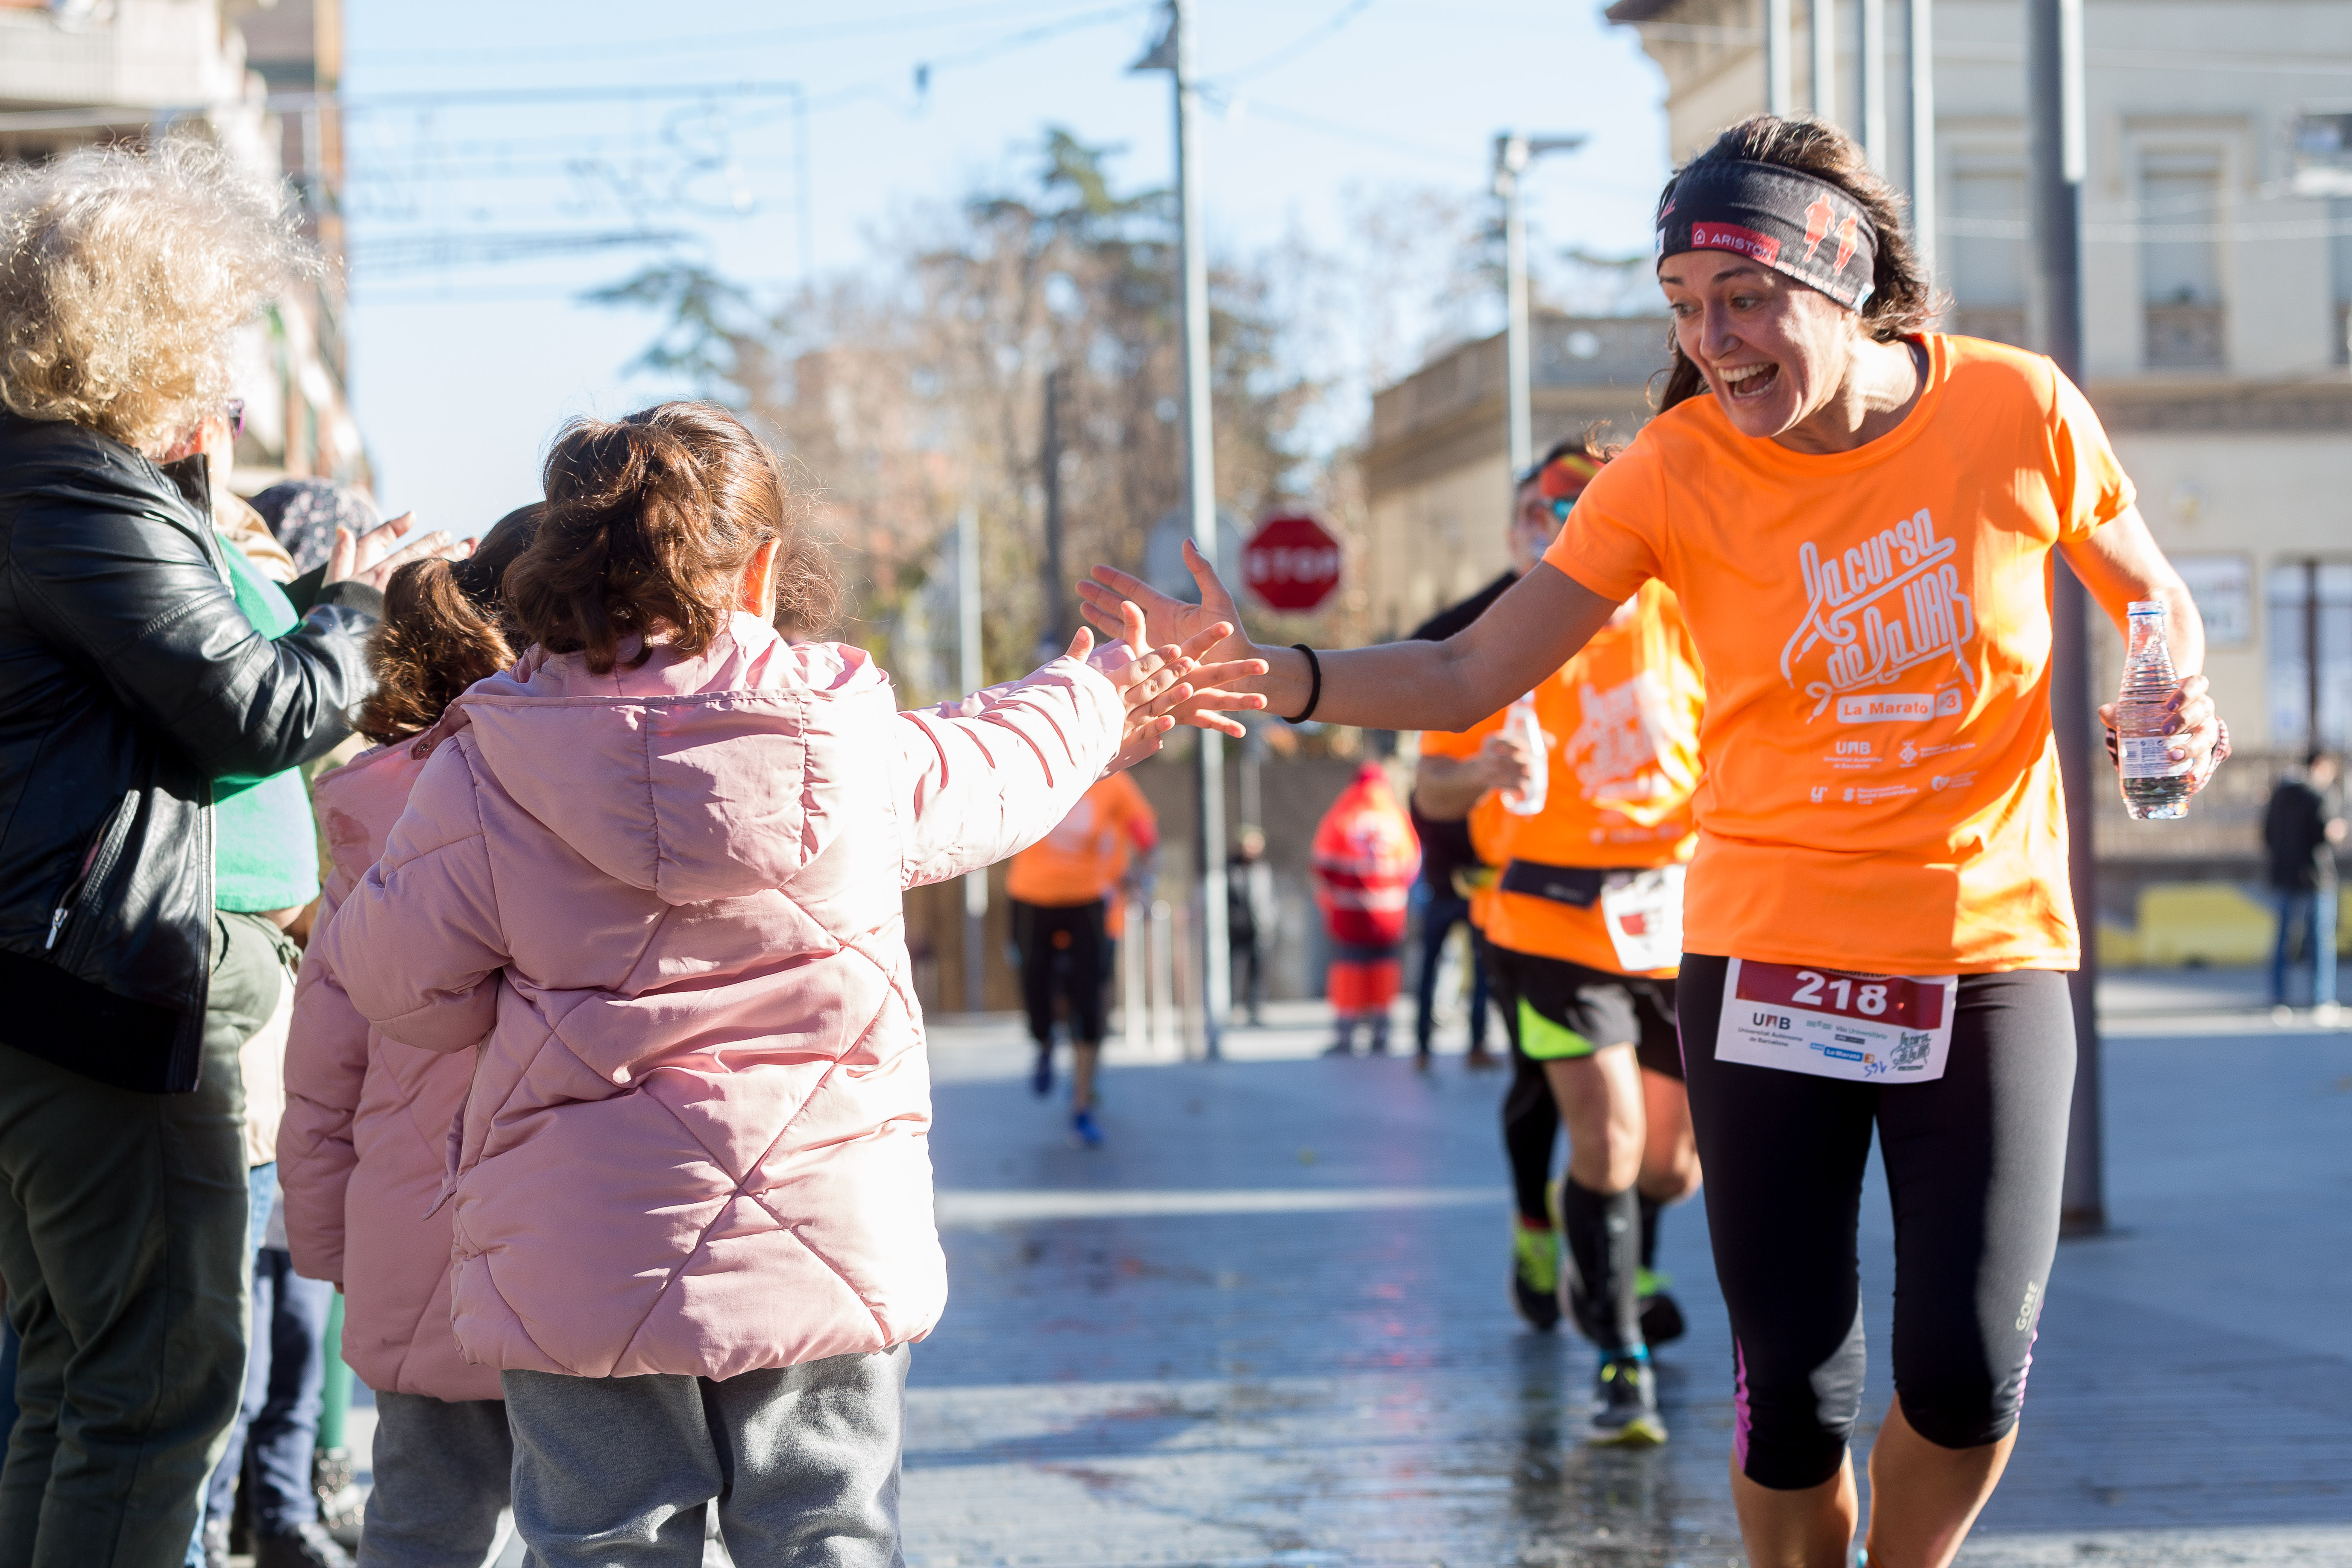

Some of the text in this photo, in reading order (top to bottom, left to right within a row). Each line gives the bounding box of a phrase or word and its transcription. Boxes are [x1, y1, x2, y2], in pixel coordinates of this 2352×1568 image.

[1710, 233, 1773, 261] ARISTON
[1844, 508, 1948, 595] cursa
[1827, 643, 1864, 688] de
[1844, 704, 1862, 716] La
[1869, 701, 1929, 716] Marató
[1836, 741, 1871, 755] UAB
[1792, 971, 1888, 1015] 218
[1753, 1012, 1791, 1030] UAB
[2015, 1281, 2039, 1331] GORE
